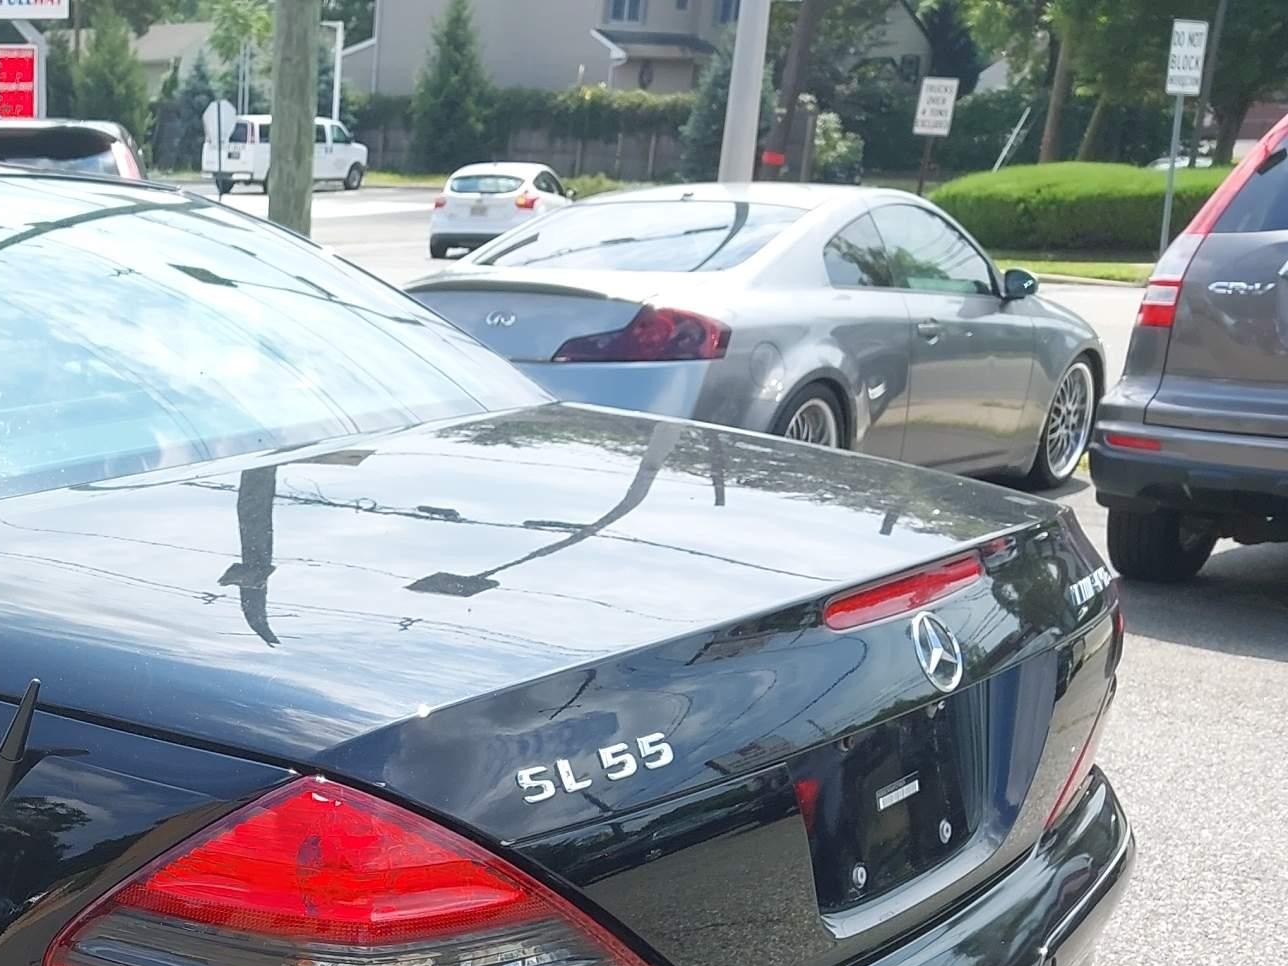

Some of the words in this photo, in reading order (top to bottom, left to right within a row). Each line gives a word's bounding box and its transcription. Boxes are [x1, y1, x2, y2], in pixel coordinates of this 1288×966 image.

[1173, 31, 1185, 47] DO
[1187, 31, 1204, 48] NOT
[1170, 54, 1201, 71] BLOCK
[1207, 281, 1275, 295] CR-V
[517, 758, 592, 804] SL
[598, 732, 674, 781] 55
